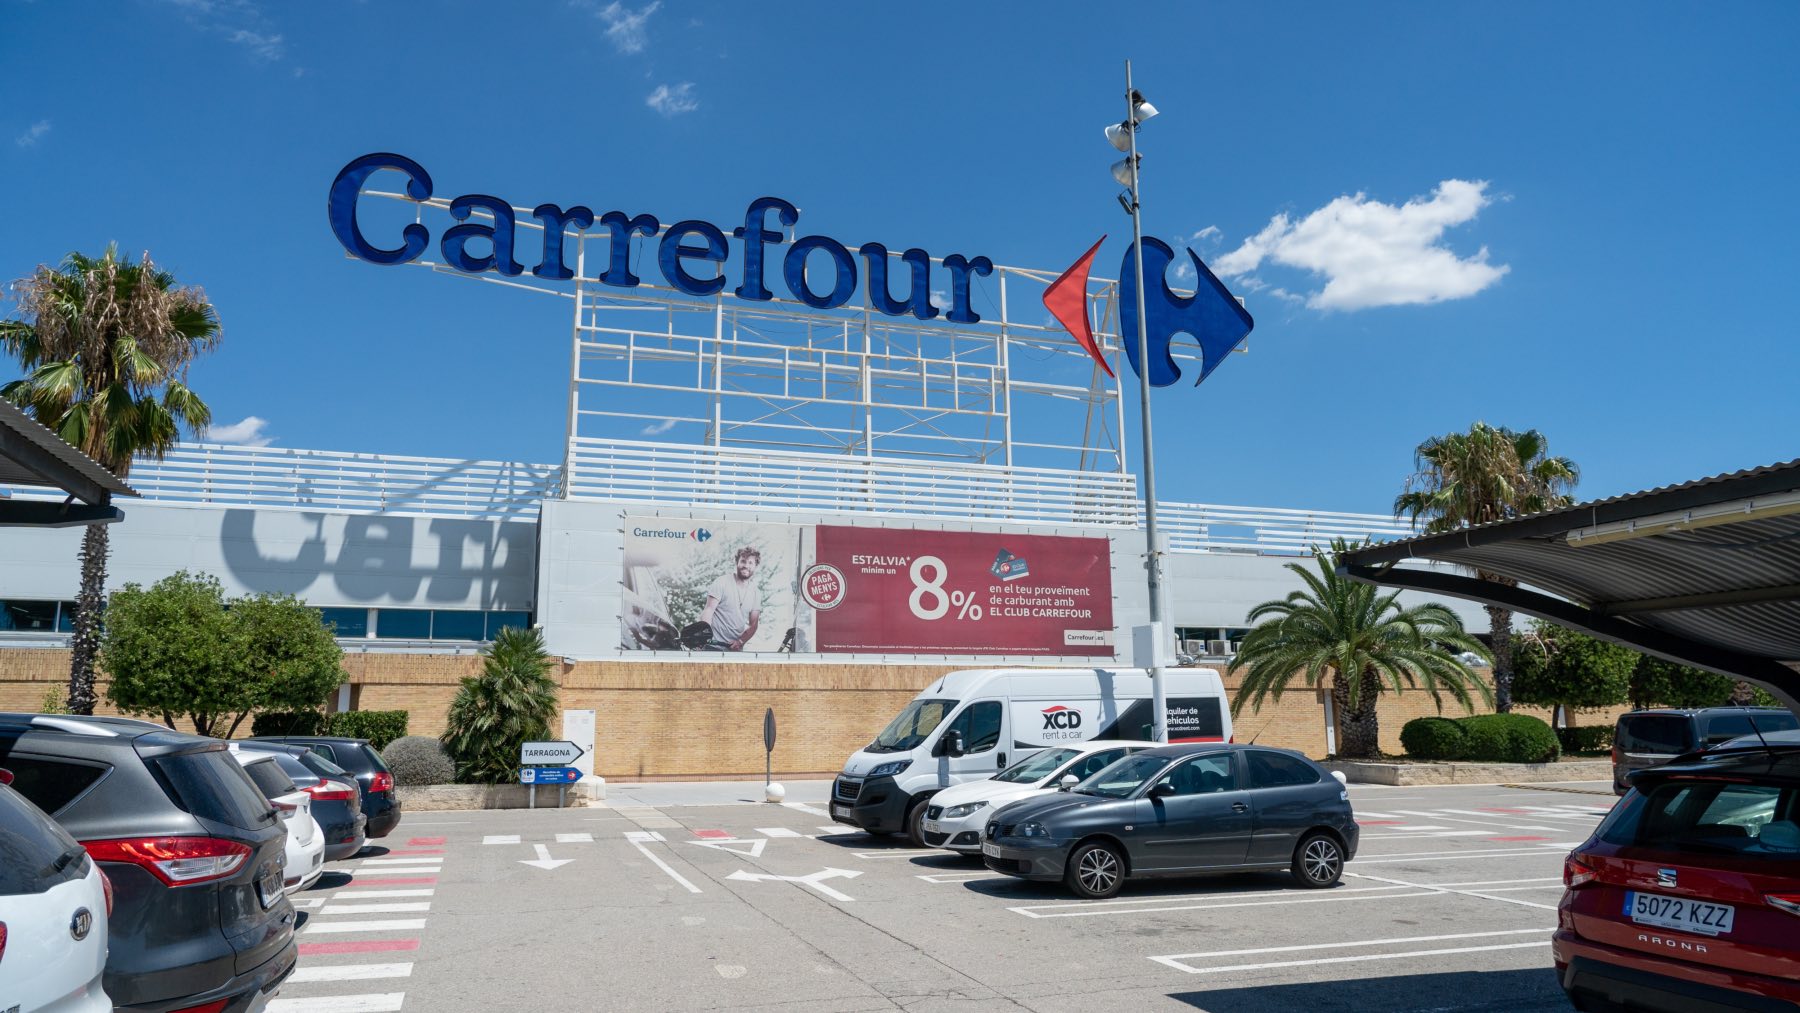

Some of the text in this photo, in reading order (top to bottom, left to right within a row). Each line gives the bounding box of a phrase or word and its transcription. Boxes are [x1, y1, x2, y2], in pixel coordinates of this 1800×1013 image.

[328, 152, 993, 323] Carrefour
[633, 527, 687, 539] Carrefour
[811, 573, 833, 586] PAGA
[810, 582, 838, 596] MENYS
[908, 555, 982, 621] 8%
[989, 584, 1091, 596] en el teu proveïment
[989, 595, 1075, 607] de carburant amb
[990, 607, 1092, 618] EL CLUB CARREFOUR
[1166, 707, 1199, 716] lquiler de
[1042, 711, 1082, 730] XCD
[1042, 731, 1083, 740] rent a car
[524, 749, 571, 757] TARRAGONA
[1637, 895, 1729, 928] 5072 KZZ
[1638, 934, 1707, 953] ARONA
